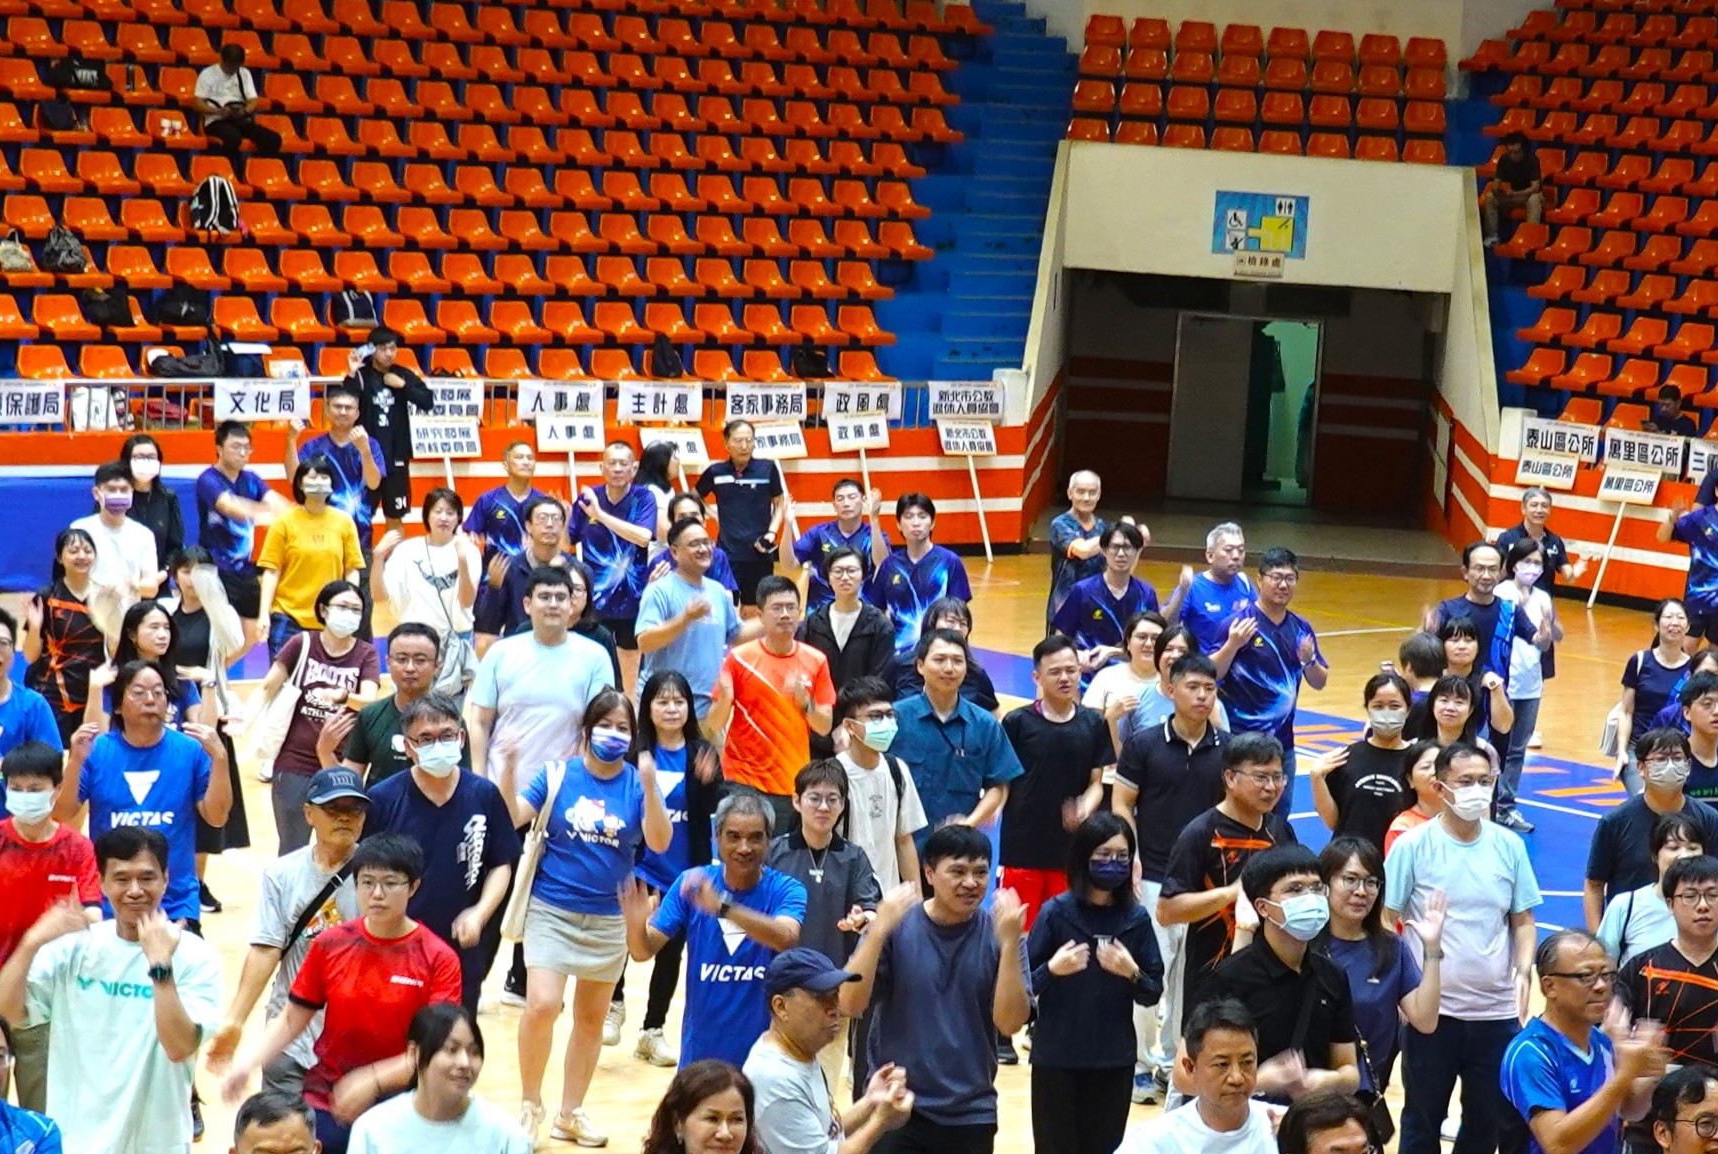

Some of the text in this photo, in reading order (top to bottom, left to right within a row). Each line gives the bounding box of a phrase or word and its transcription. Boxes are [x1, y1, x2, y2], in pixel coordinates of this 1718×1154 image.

[230, 390, 296, 413] 文化局
[531, 391, 592, 412] 人事處
[632, 393, 688, 415] 主計處
[730, 393, 803, 415] 客家事務局
[836, 393, 889, 412] 政風處
[549, 425, 596, 439] 人事處
[755, 433, 801, 448] 家事務局
[838, 423, 880, 440] 政風處
[1526, 427, 1595, 456] 泰山區公所
[1609, 438, 1679, 467] 萬里區公所
[1521, 459, 1573, 479] 泰山區公所
[1603, 476, 1654, 494] 萬里區公所
[111, 811, 174, 829] VICTAS
[700, 963, 766, 982] VICTAS
